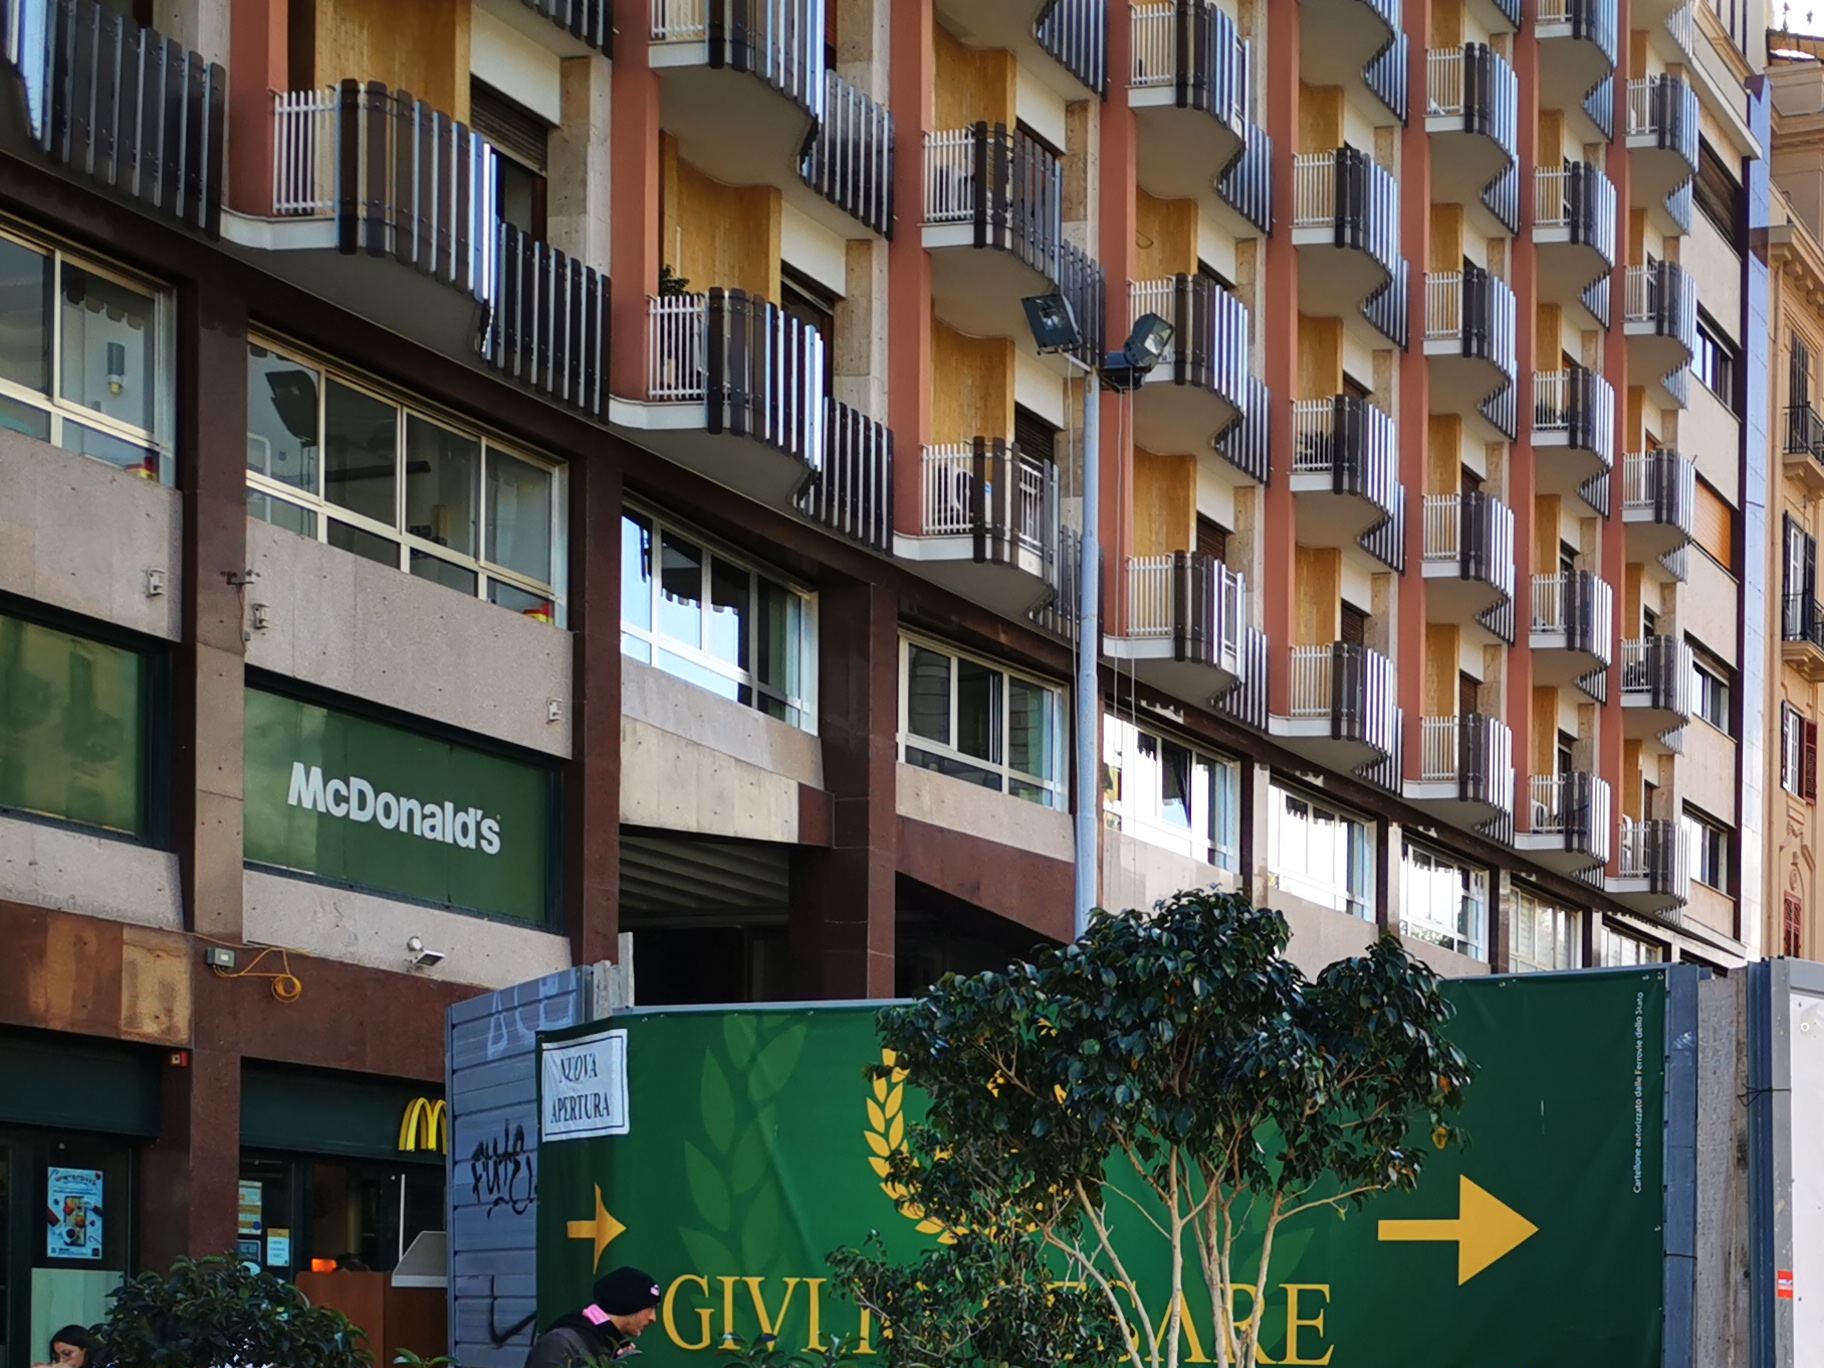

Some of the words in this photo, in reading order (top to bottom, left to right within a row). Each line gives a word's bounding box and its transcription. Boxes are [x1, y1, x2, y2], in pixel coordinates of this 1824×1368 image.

[288, 761, 500, 855] McDonald's
[1635, 991, 1644, 1015] Stato
[1635, 1016, 1643, 1038] dello
[1635, 1040, 1643, 1075] Ferrovie
[1634, 1076, 1642, 1097] dalle
[550, 1091, 610, 1123] APERTURA
[1634, 1099, 1642, 1147] autorizzato
[1633, 1148, 1642, 1194] Cartellone
